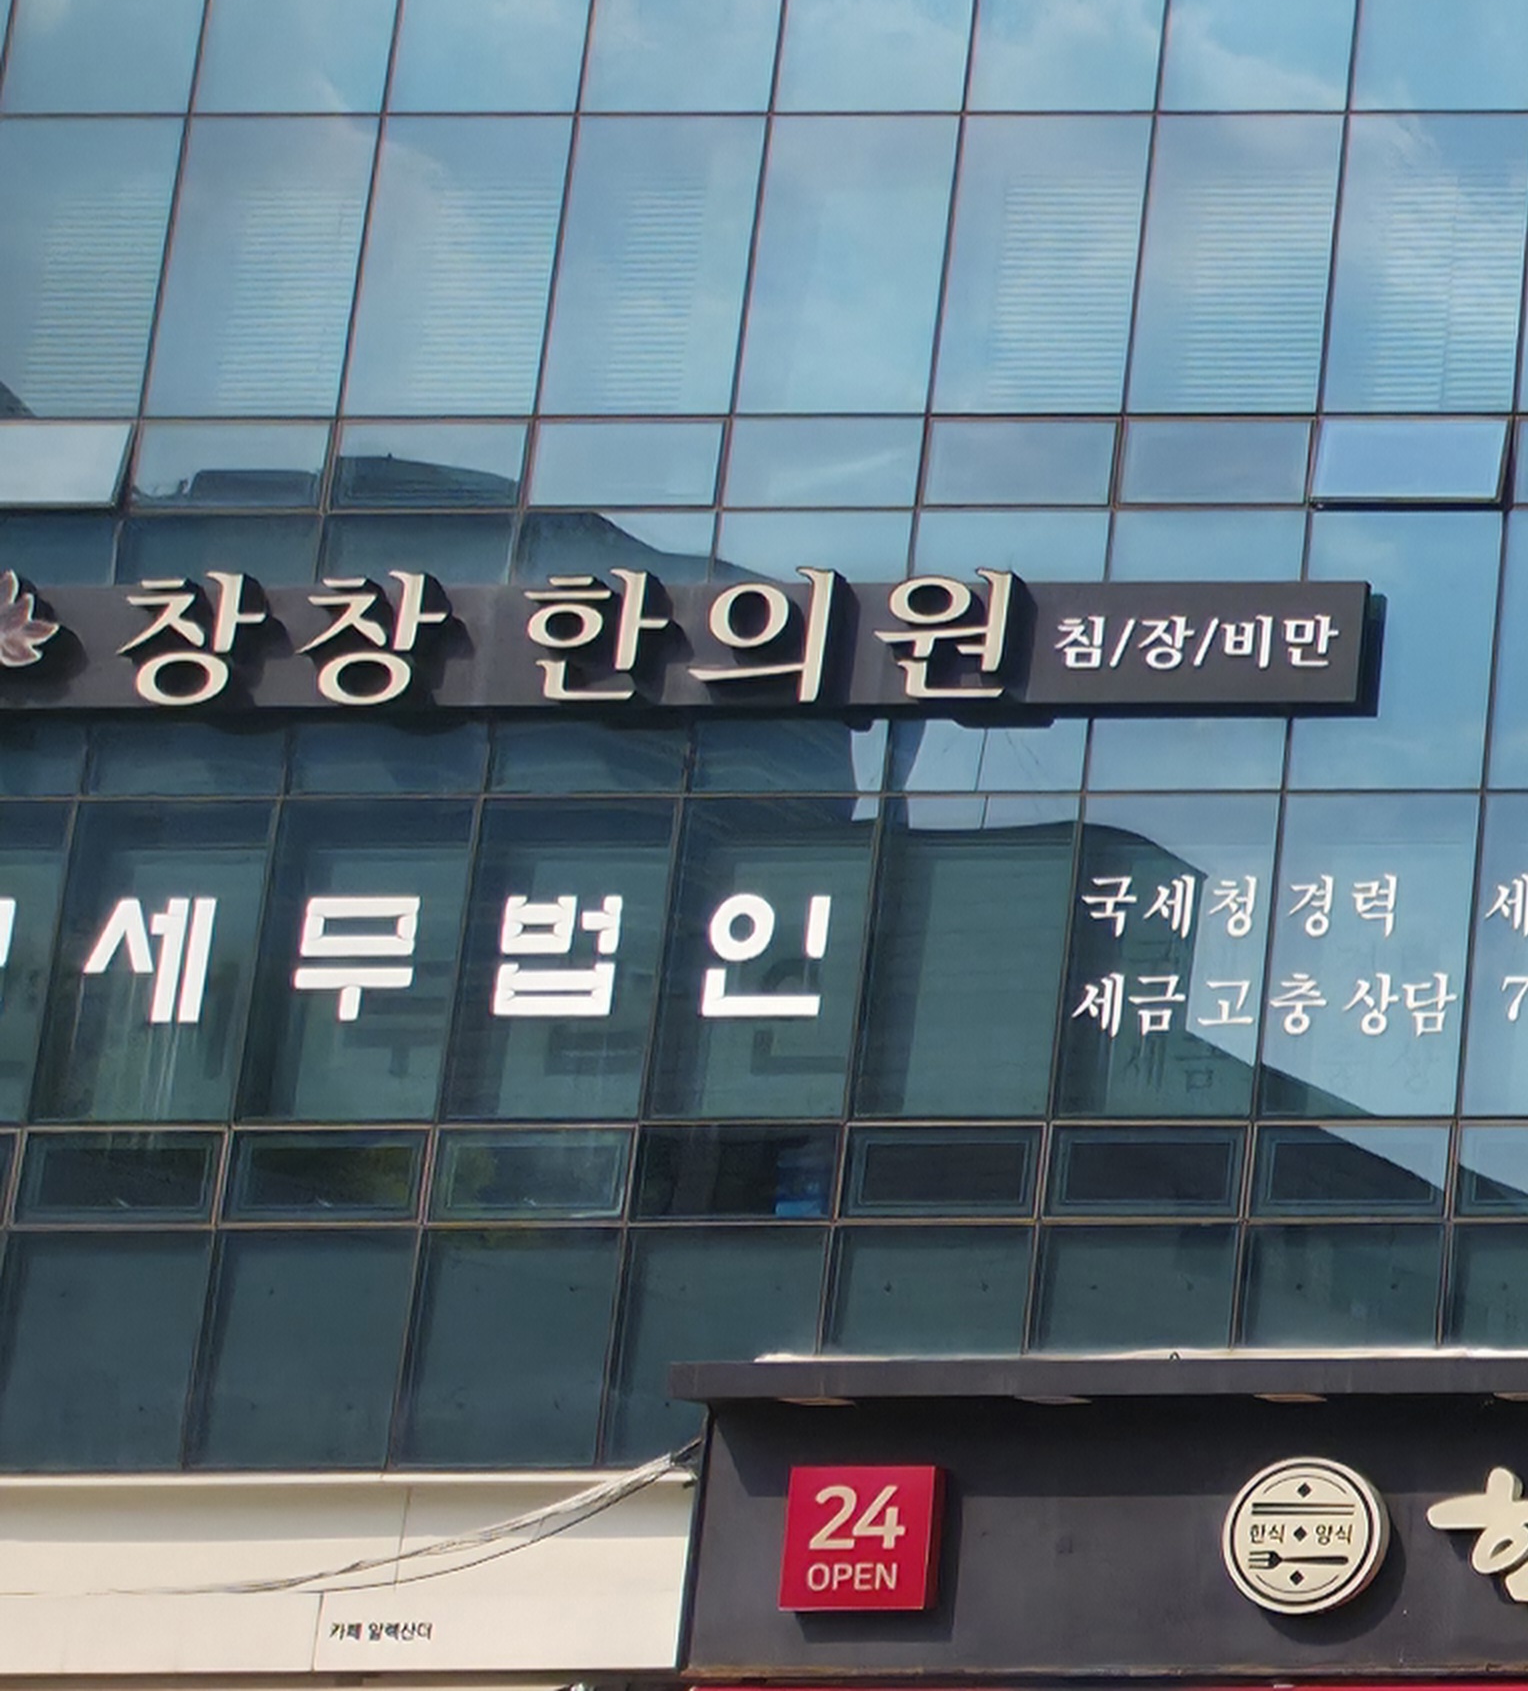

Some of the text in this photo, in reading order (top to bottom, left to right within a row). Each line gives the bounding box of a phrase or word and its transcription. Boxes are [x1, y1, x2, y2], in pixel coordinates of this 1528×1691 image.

[116, 565, 1013, 705] 창창 한의원
[1054, 612, 1340, 671] 침/장/비만
[1081, 872, 1259, 940] 국세청
[1288, 872, 1401, 939] 경력
[0, 891, 832, 1024] 세무법인
[1343, 972, 1457, 1036] 상담
[807, 1484, 908, 1551] 24
[1248, 1521, 1354, 1546] 한식 양식
[804, 1559, 899, 1593] OPEN
[329, 1621, 363, 1641] 카페
